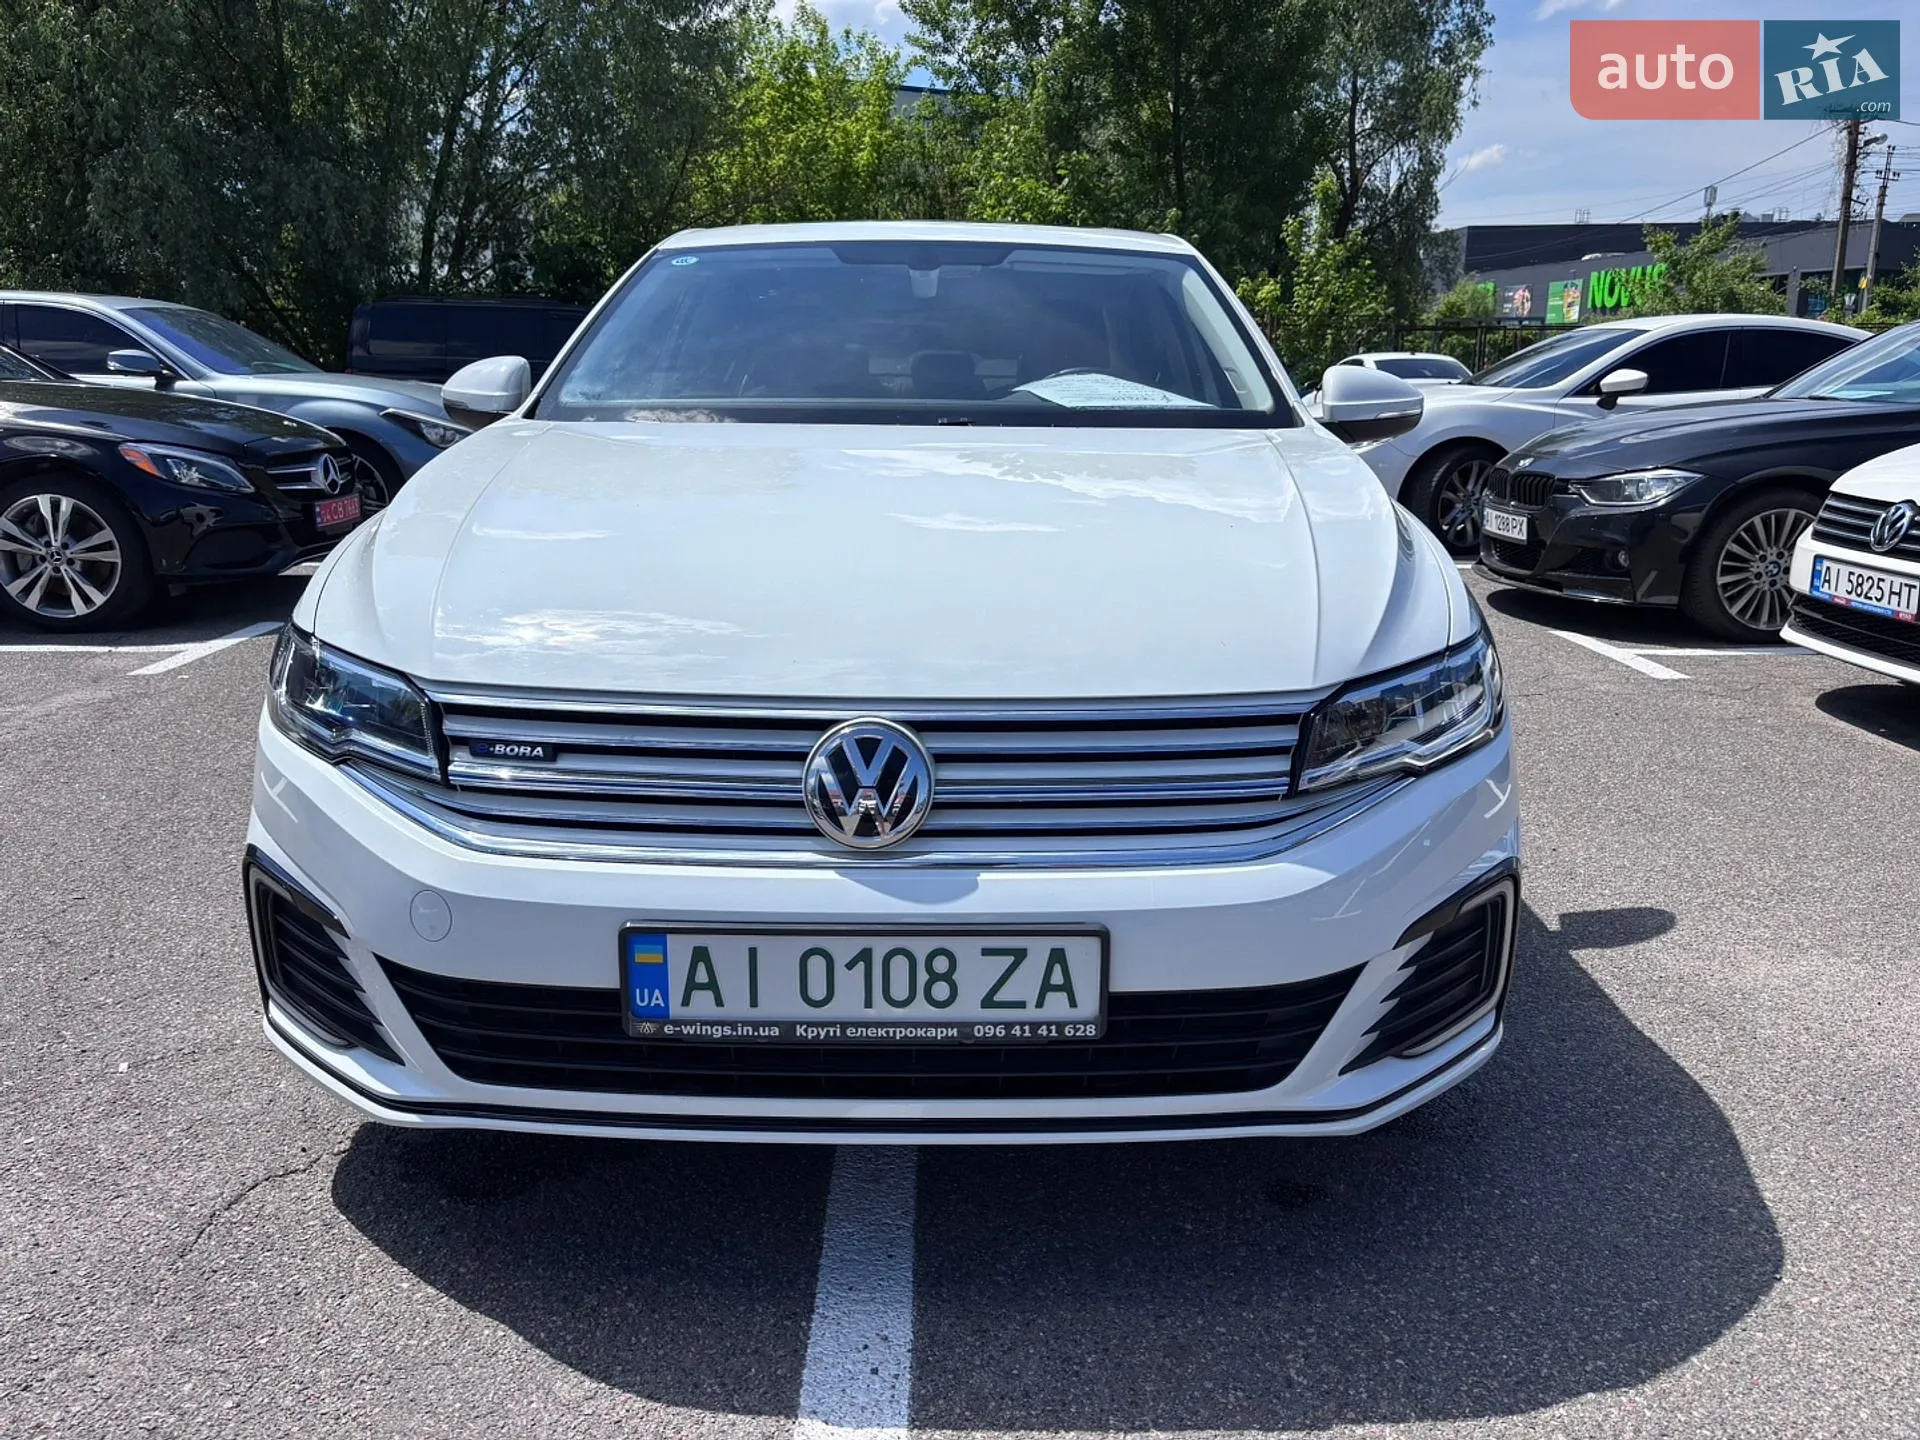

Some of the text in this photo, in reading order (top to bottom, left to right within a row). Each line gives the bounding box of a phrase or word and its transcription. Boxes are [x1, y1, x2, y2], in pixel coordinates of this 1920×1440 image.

[1821, 565, 1841, 593] AI
[1845, 571, 1886, 603] 5825
[1887, 580, 1918, 610] HT
[680, 945, 1078, 1011] AI 0108 ZA
[635, 988, 665, 1007] UA
[663, 1023, 780, 1038] e-wings.in.ua
[796, 1024, 1097, 1040] Круті електрокари 096 41 41 628
